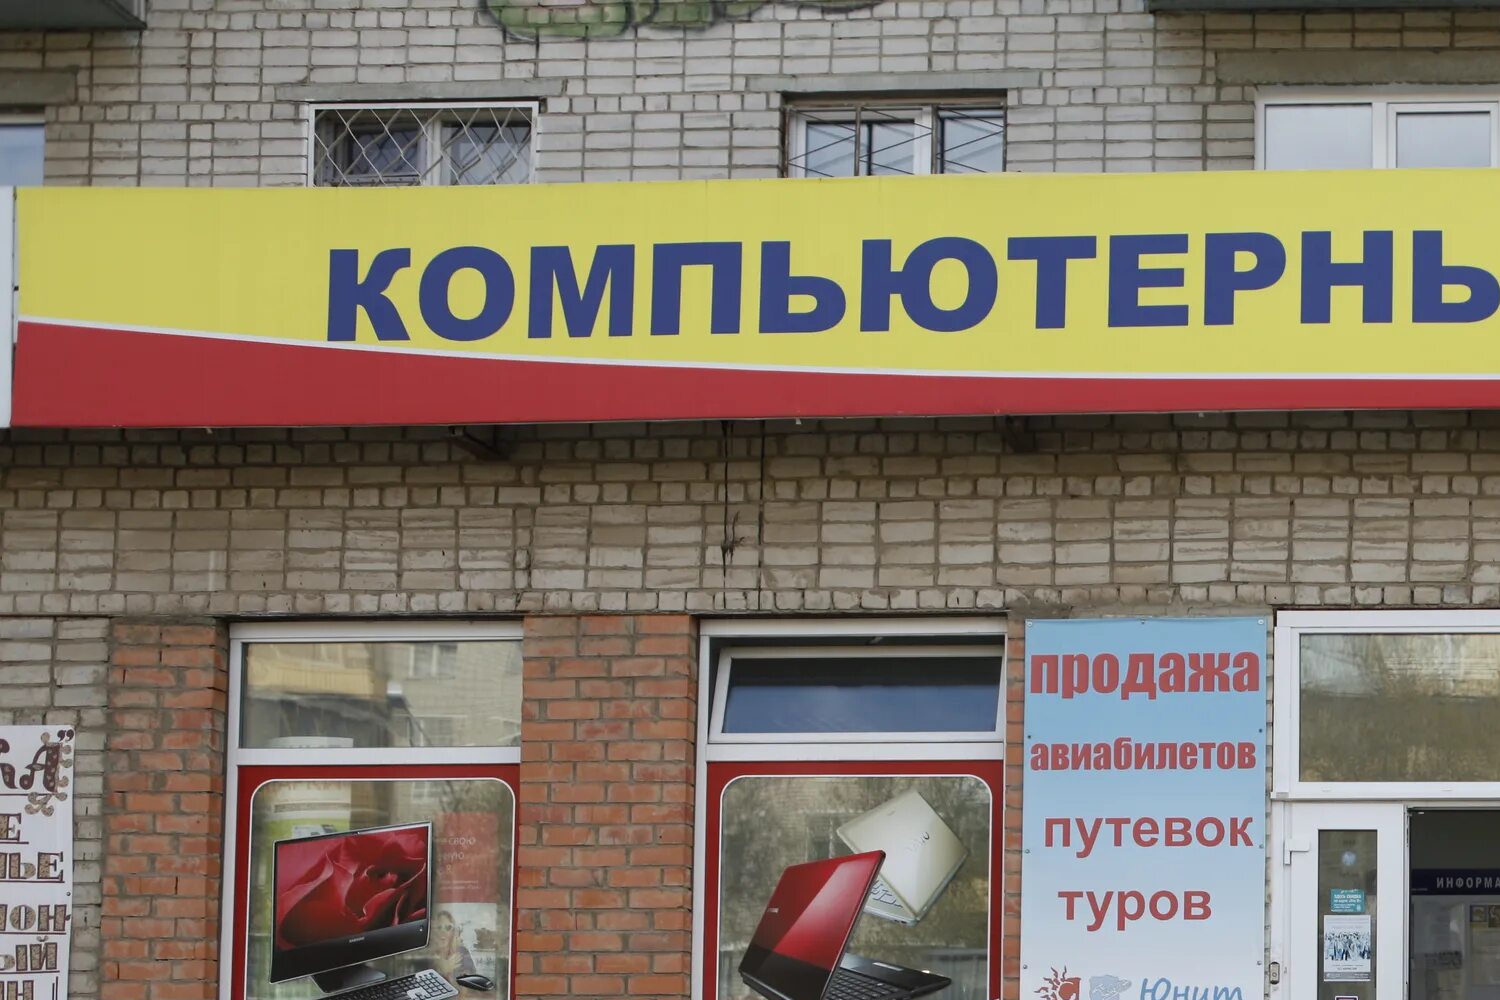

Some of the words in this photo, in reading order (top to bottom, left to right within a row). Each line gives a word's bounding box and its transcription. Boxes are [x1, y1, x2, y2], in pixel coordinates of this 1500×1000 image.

[1031, 652, 1259, 700] продажа
[1031, 737, 1256, 770] авиабилетов
[1044, 817, 1253, 859] путевок
[0, 851, 64, 881] ЬЕ
[0, 904, 67, 932] ОН
[1058, 890, 1213, 932] туров
